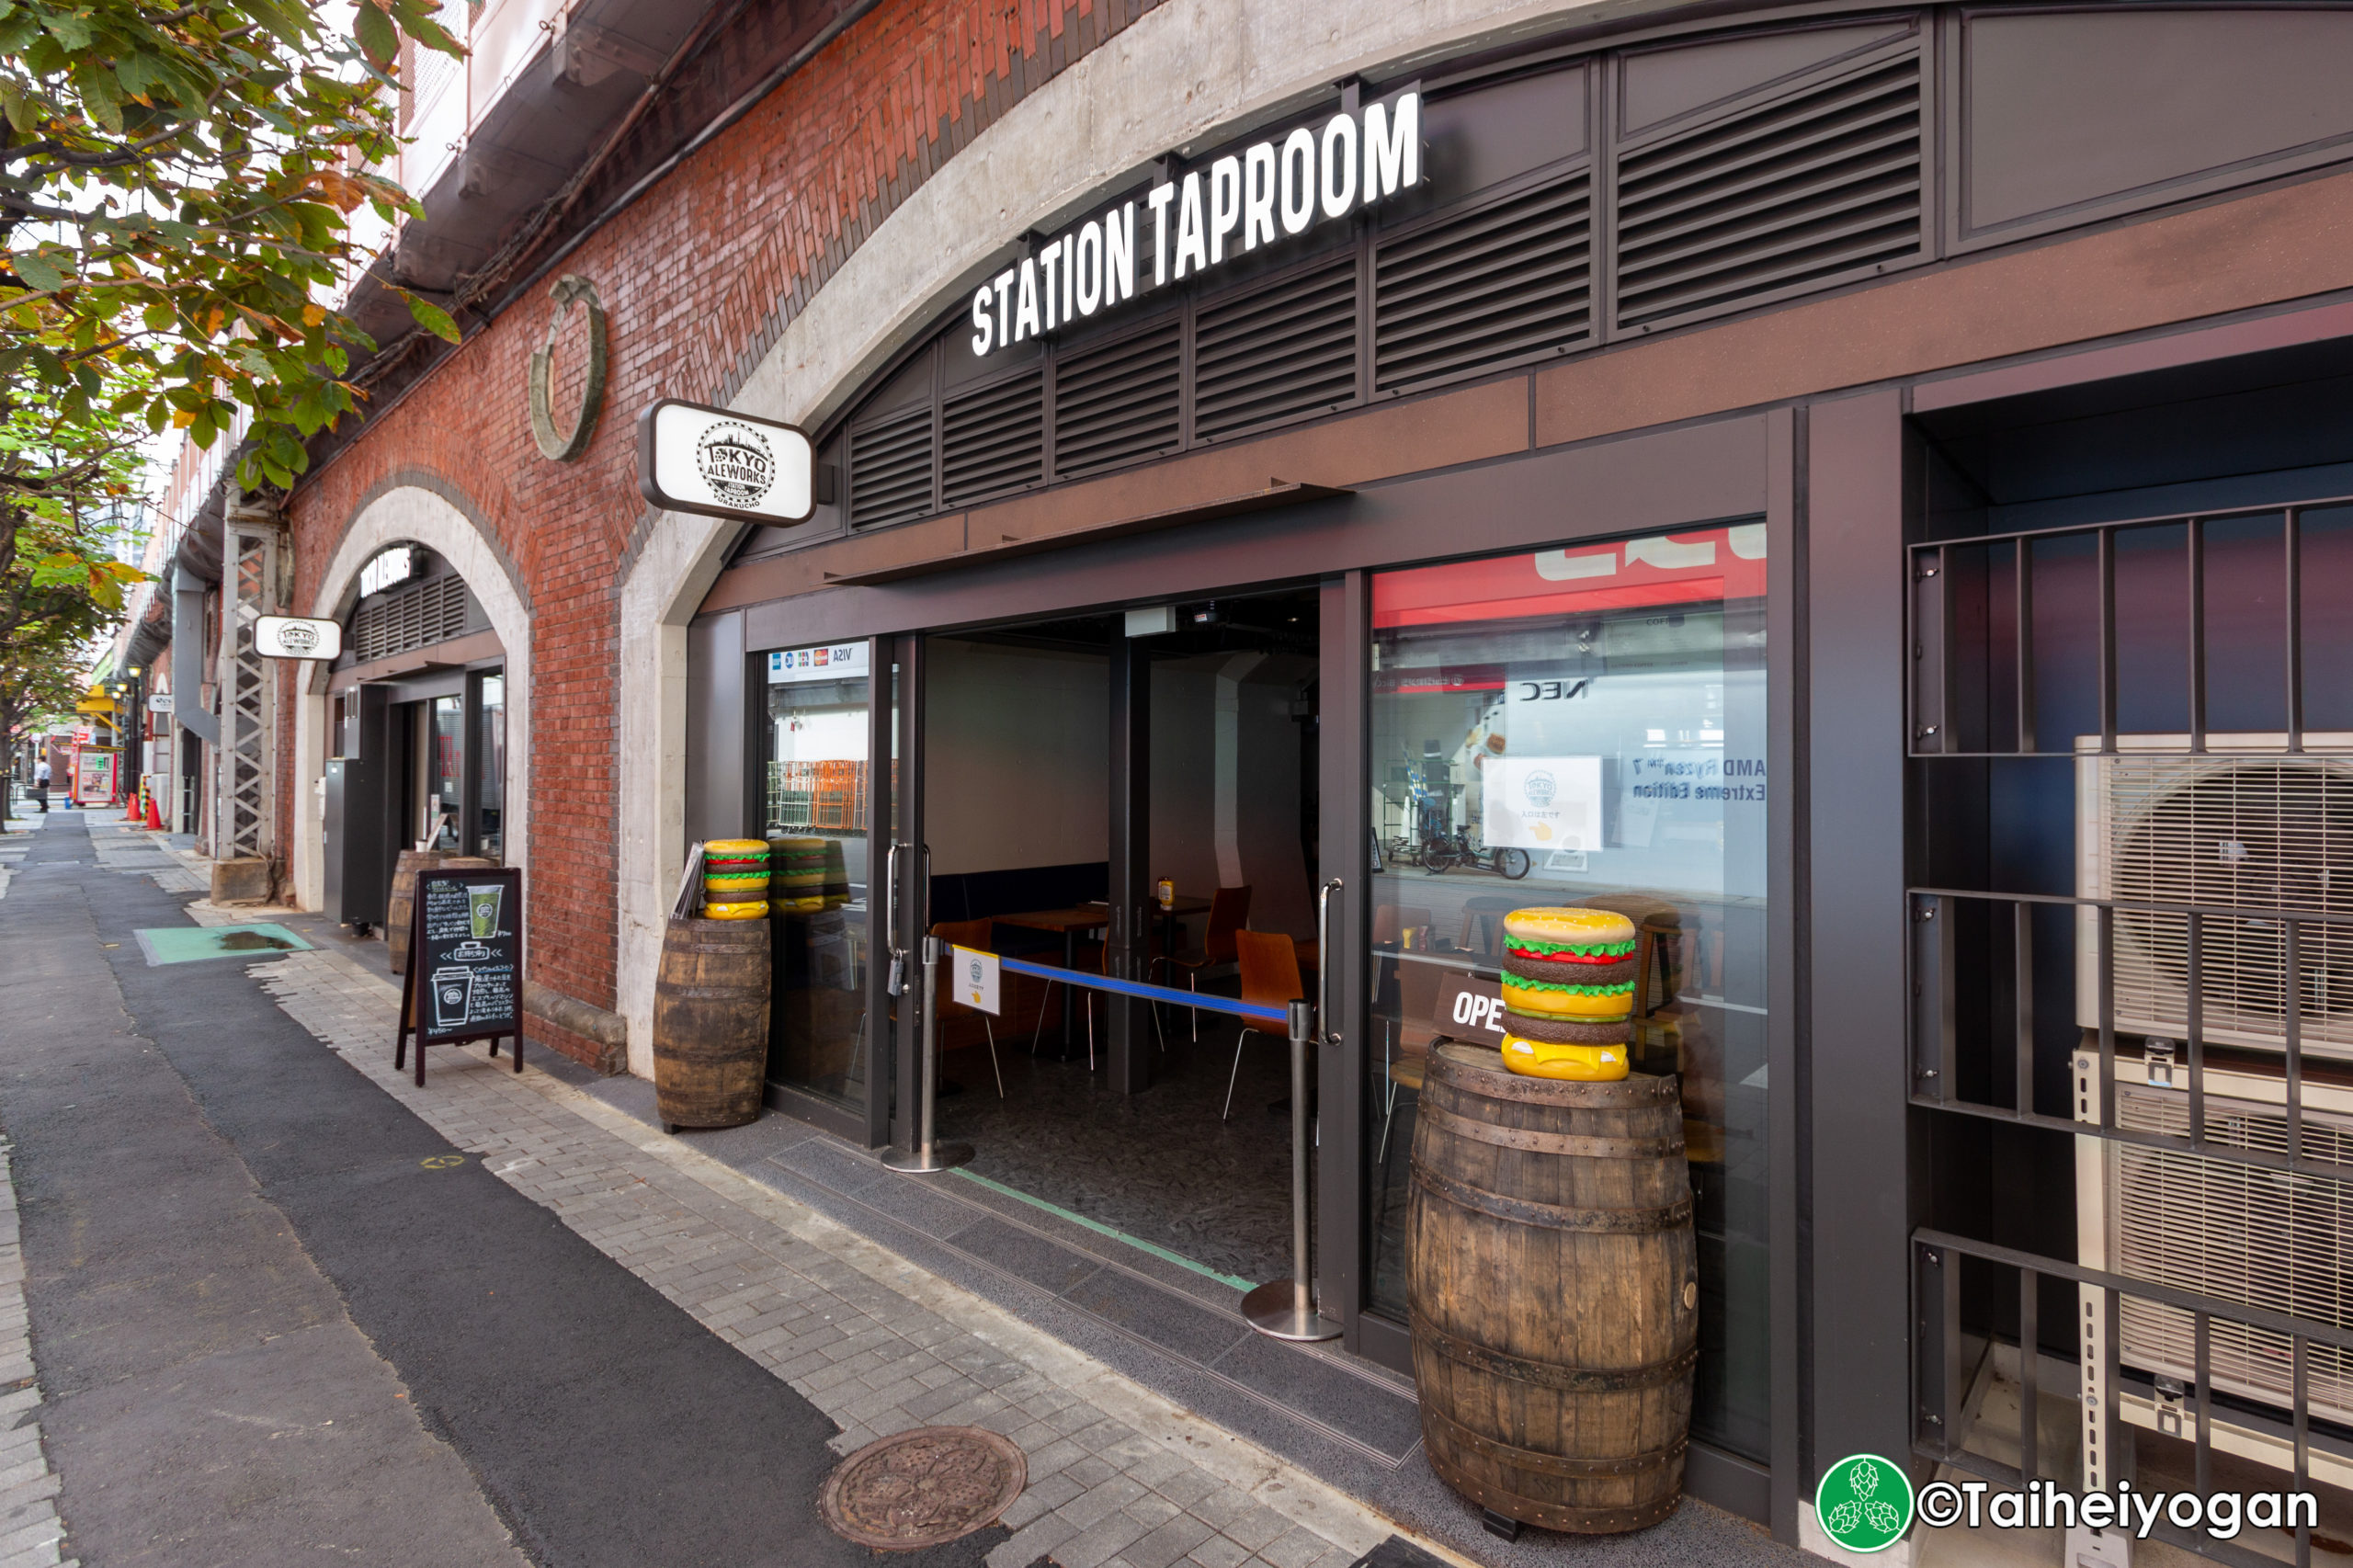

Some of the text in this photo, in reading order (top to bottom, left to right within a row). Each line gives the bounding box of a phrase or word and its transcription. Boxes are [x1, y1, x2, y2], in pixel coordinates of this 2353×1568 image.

[972, 92, 1421, 358] STATION TAPROOM
[704, 445, 767, 473] TOKYO
[707, 463, 767, 485] ALEWORKS
[712, 493, 760, 509] YURAKUCHO
[1452, 991, 1506, 1033] OPE
